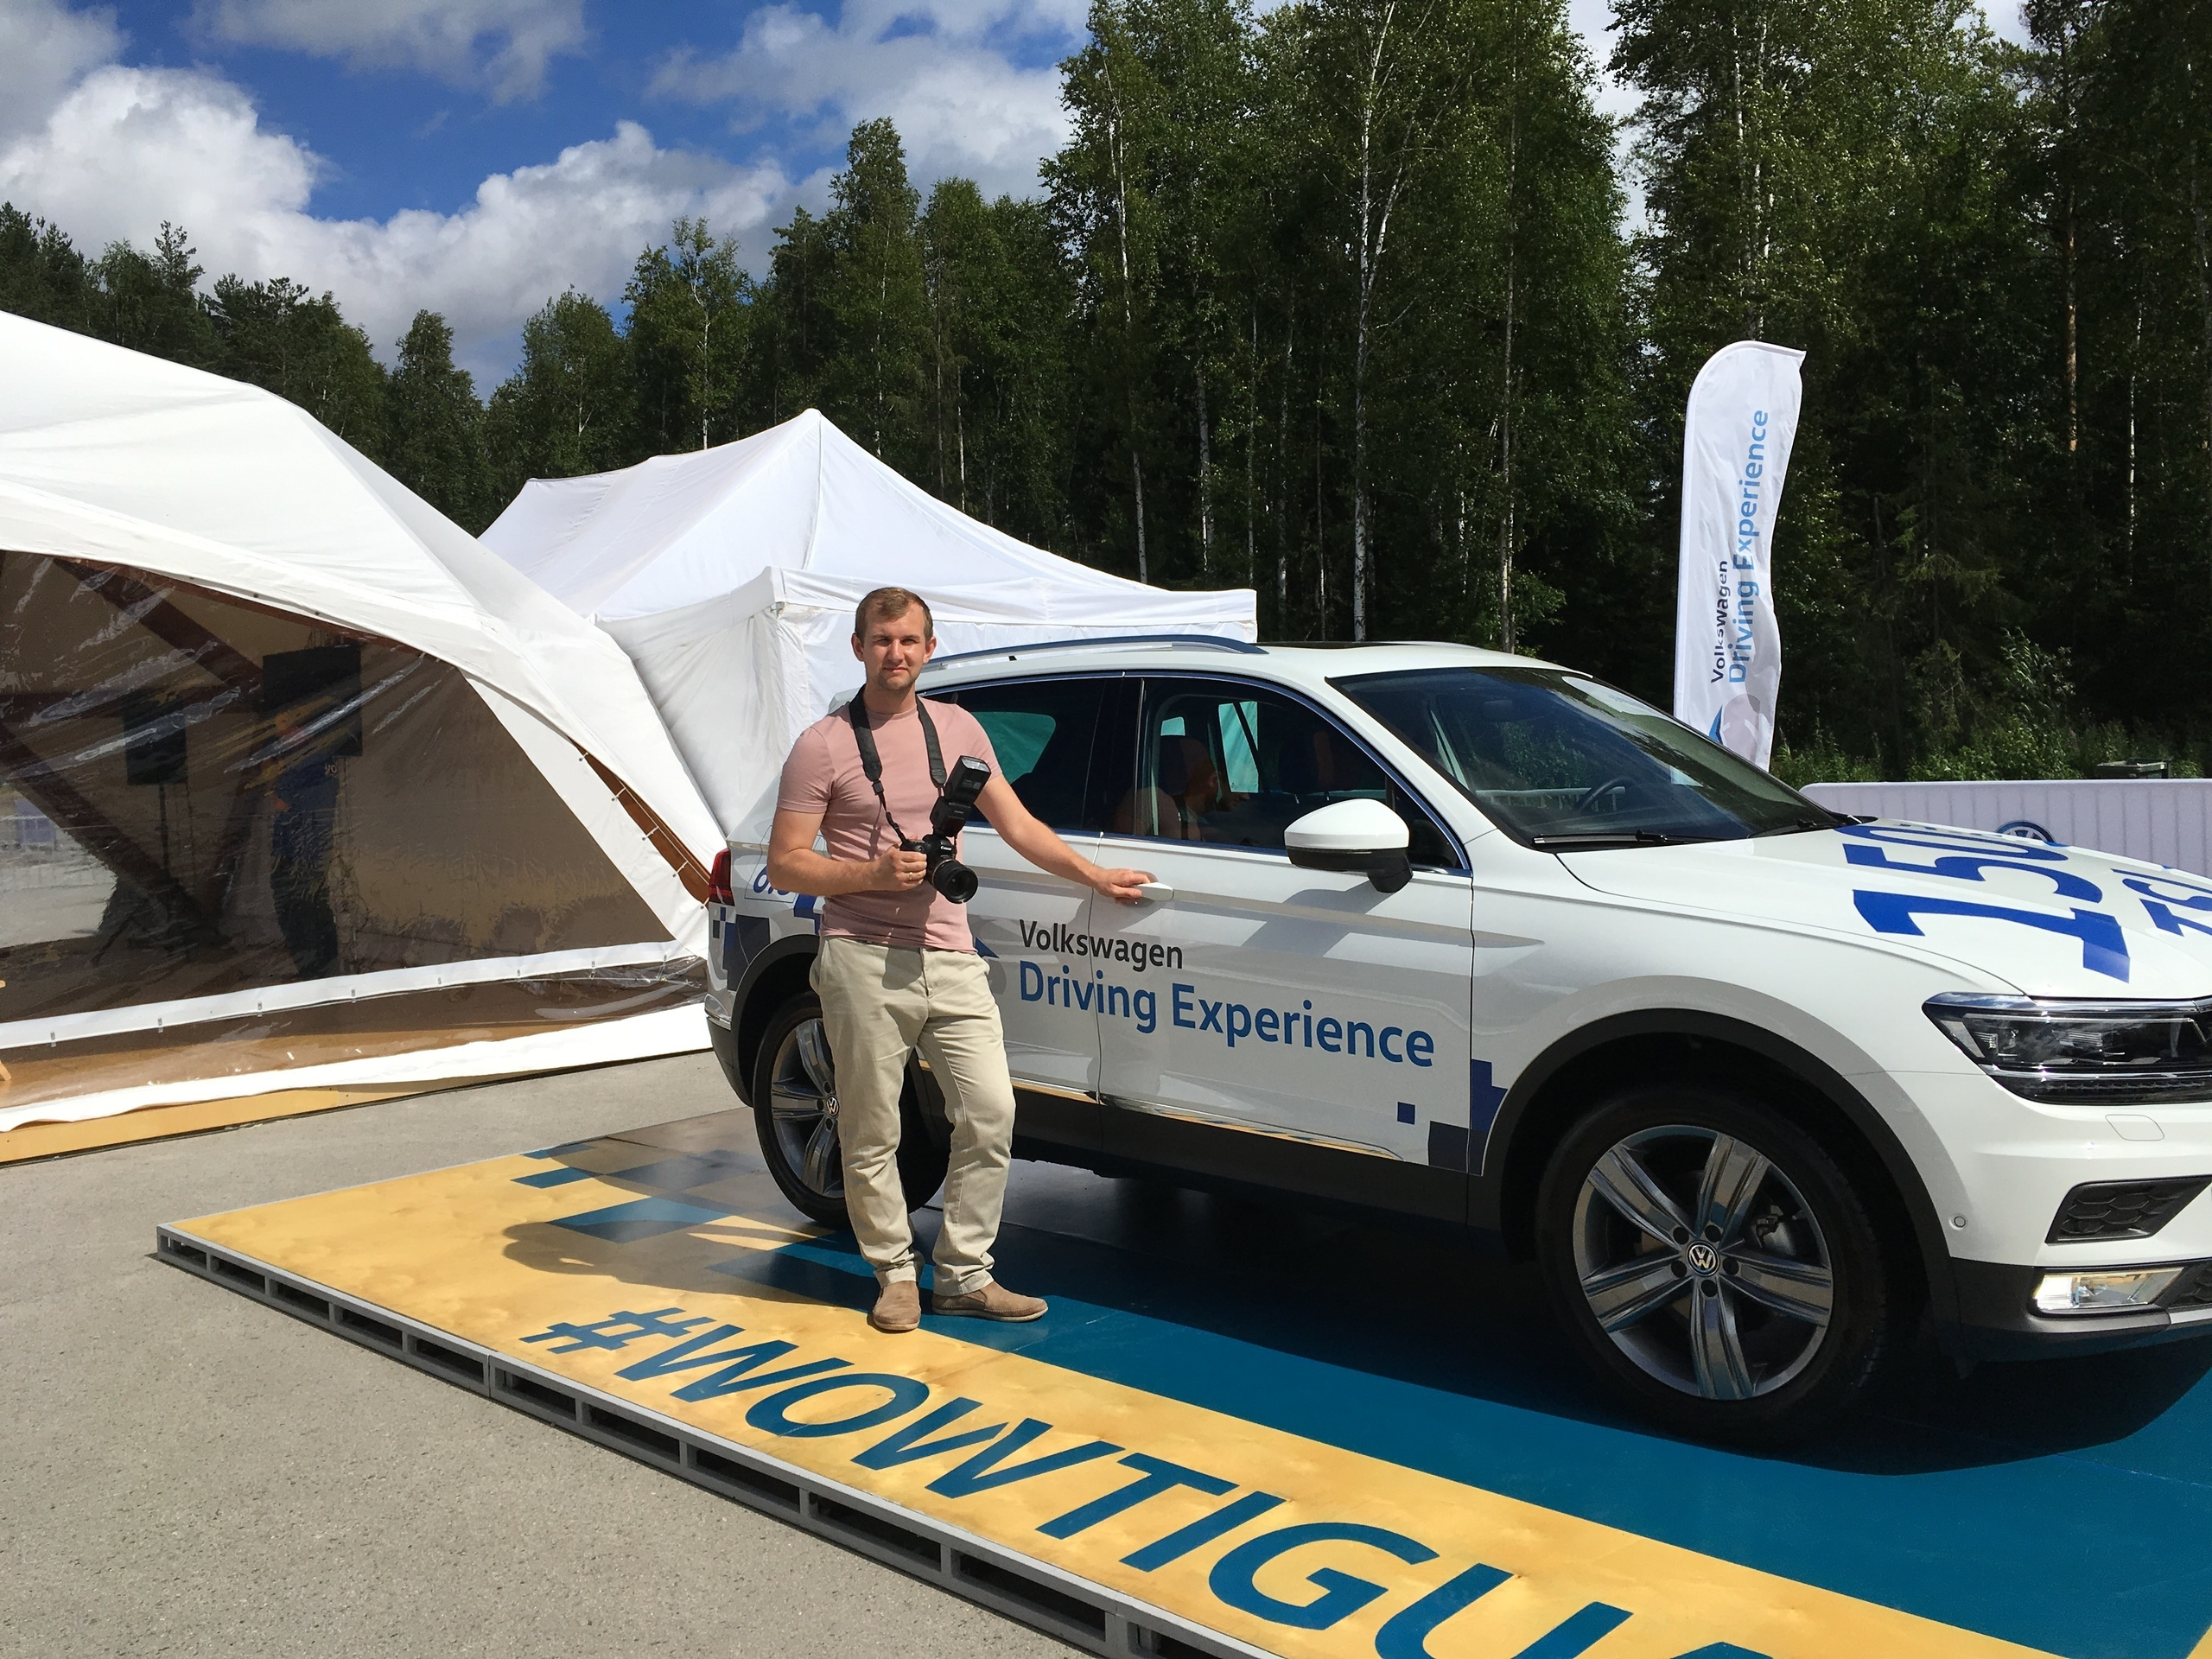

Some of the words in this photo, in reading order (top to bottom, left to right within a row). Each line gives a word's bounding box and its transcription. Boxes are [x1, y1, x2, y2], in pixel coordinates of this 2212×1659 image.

[1732, 410, 1769, 569] Experience
[1711, 561, 1731, 683] Volkswagen
[1728, 581, 1760, 683] Driving
[1019, 918, 1184, 973] Volkswagen
[1020, 960, 1156, 1034] Driving
[1172, 982, 1434, 1068] Experience
[518, 1306, 1776, 1659] #WOWTIGU
